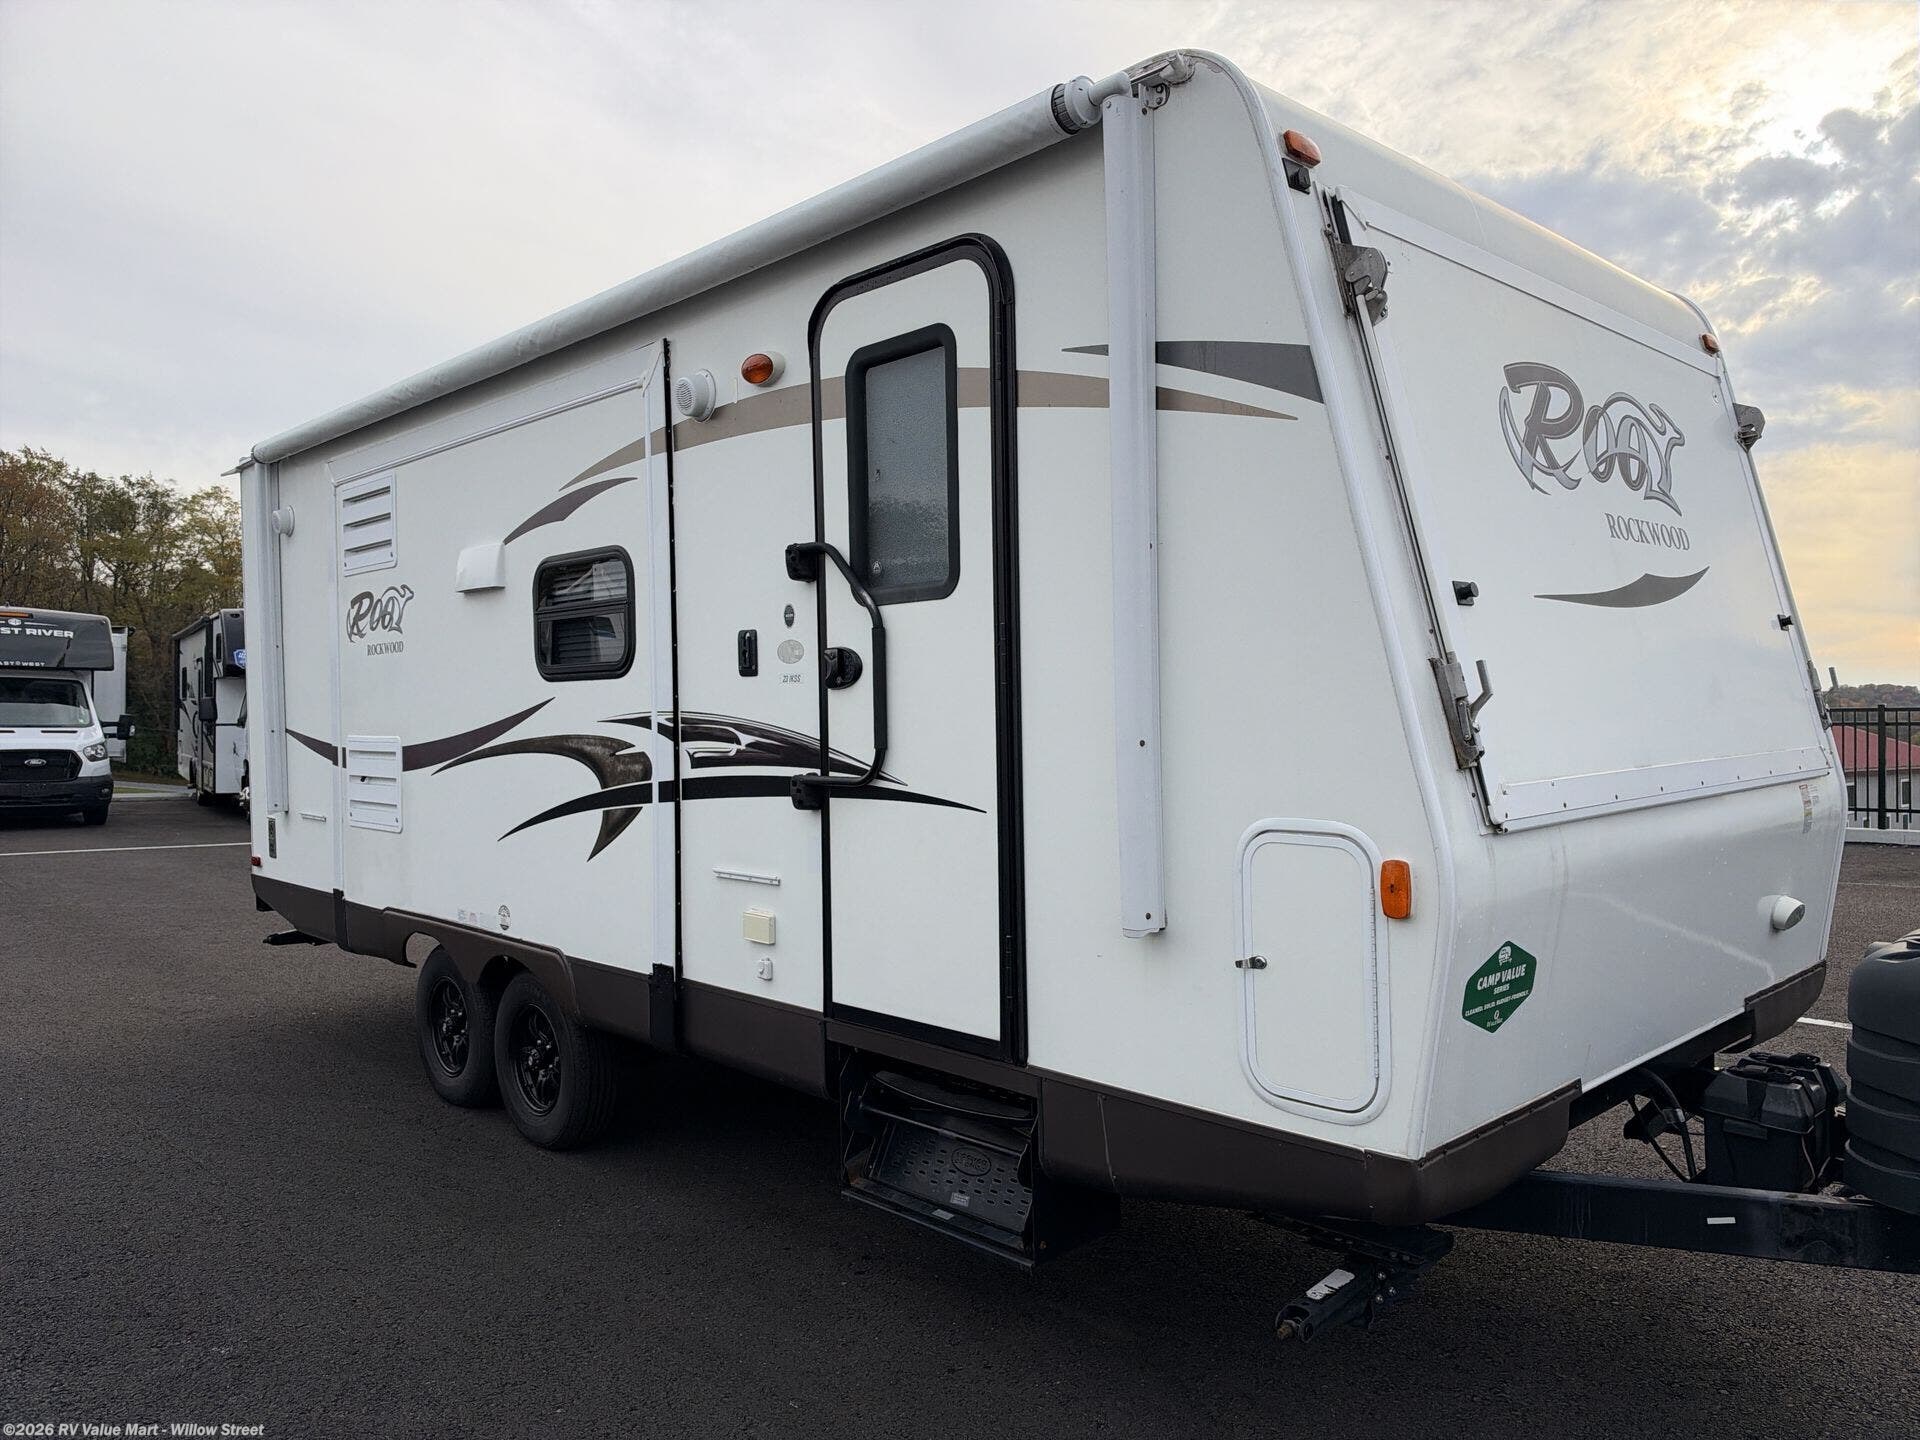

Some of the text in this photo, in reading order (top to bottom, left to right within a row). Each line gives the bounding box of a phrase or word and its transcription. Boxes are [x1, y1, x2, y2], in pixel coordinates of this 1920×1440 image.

[1605, 512, 1690, 550] ROCKWOOD
[25, 628, 74, 639] RIVER
[367, 641, 404, 656] ROCKWOOD
[1477, 964, 1526, 990] CAMP VALUE
